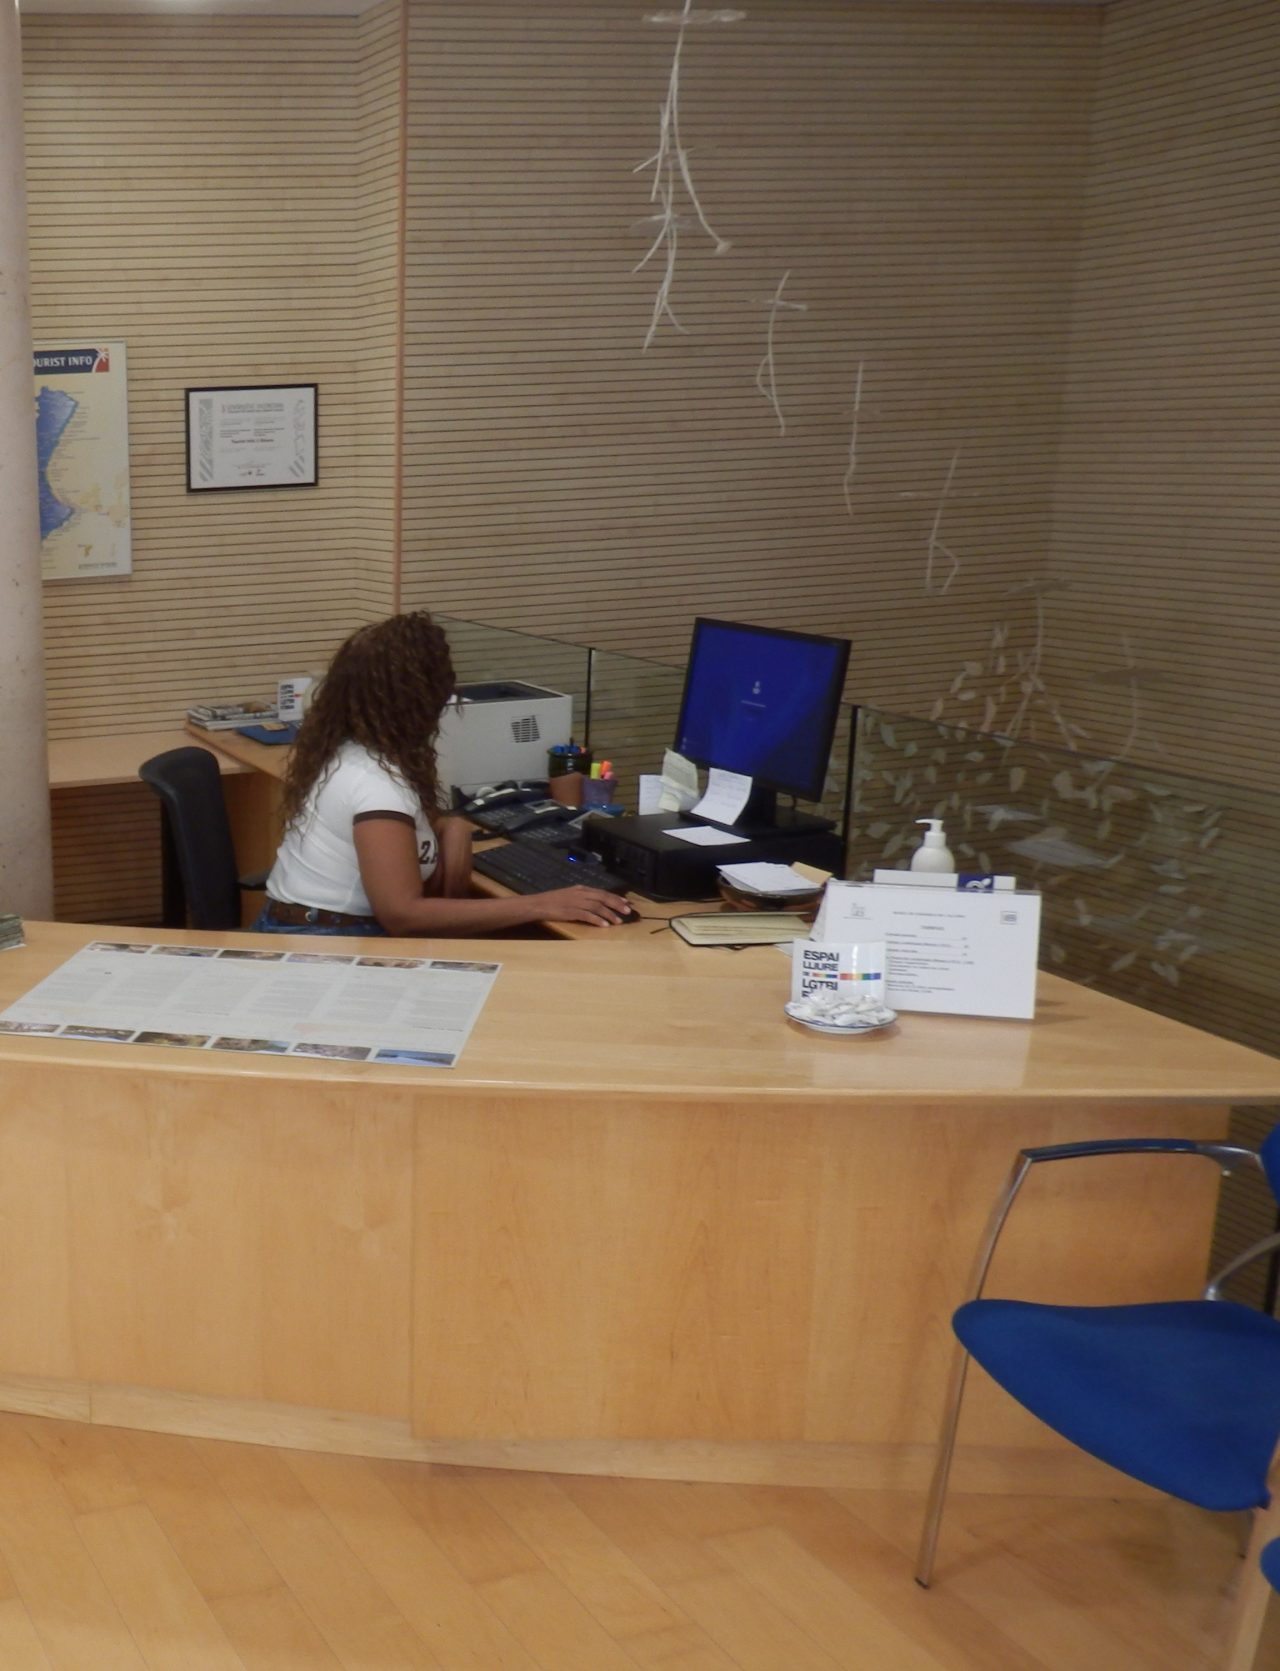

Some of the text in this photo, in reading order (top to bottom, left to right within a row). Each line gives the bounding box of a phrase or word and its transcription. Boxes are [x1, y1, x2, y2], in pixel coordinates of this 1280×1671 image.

[68, 355, 93, 366] INFO
[803, 950, 840, 962] ESPAI
[802, 978, 839, 991] LGTBI
